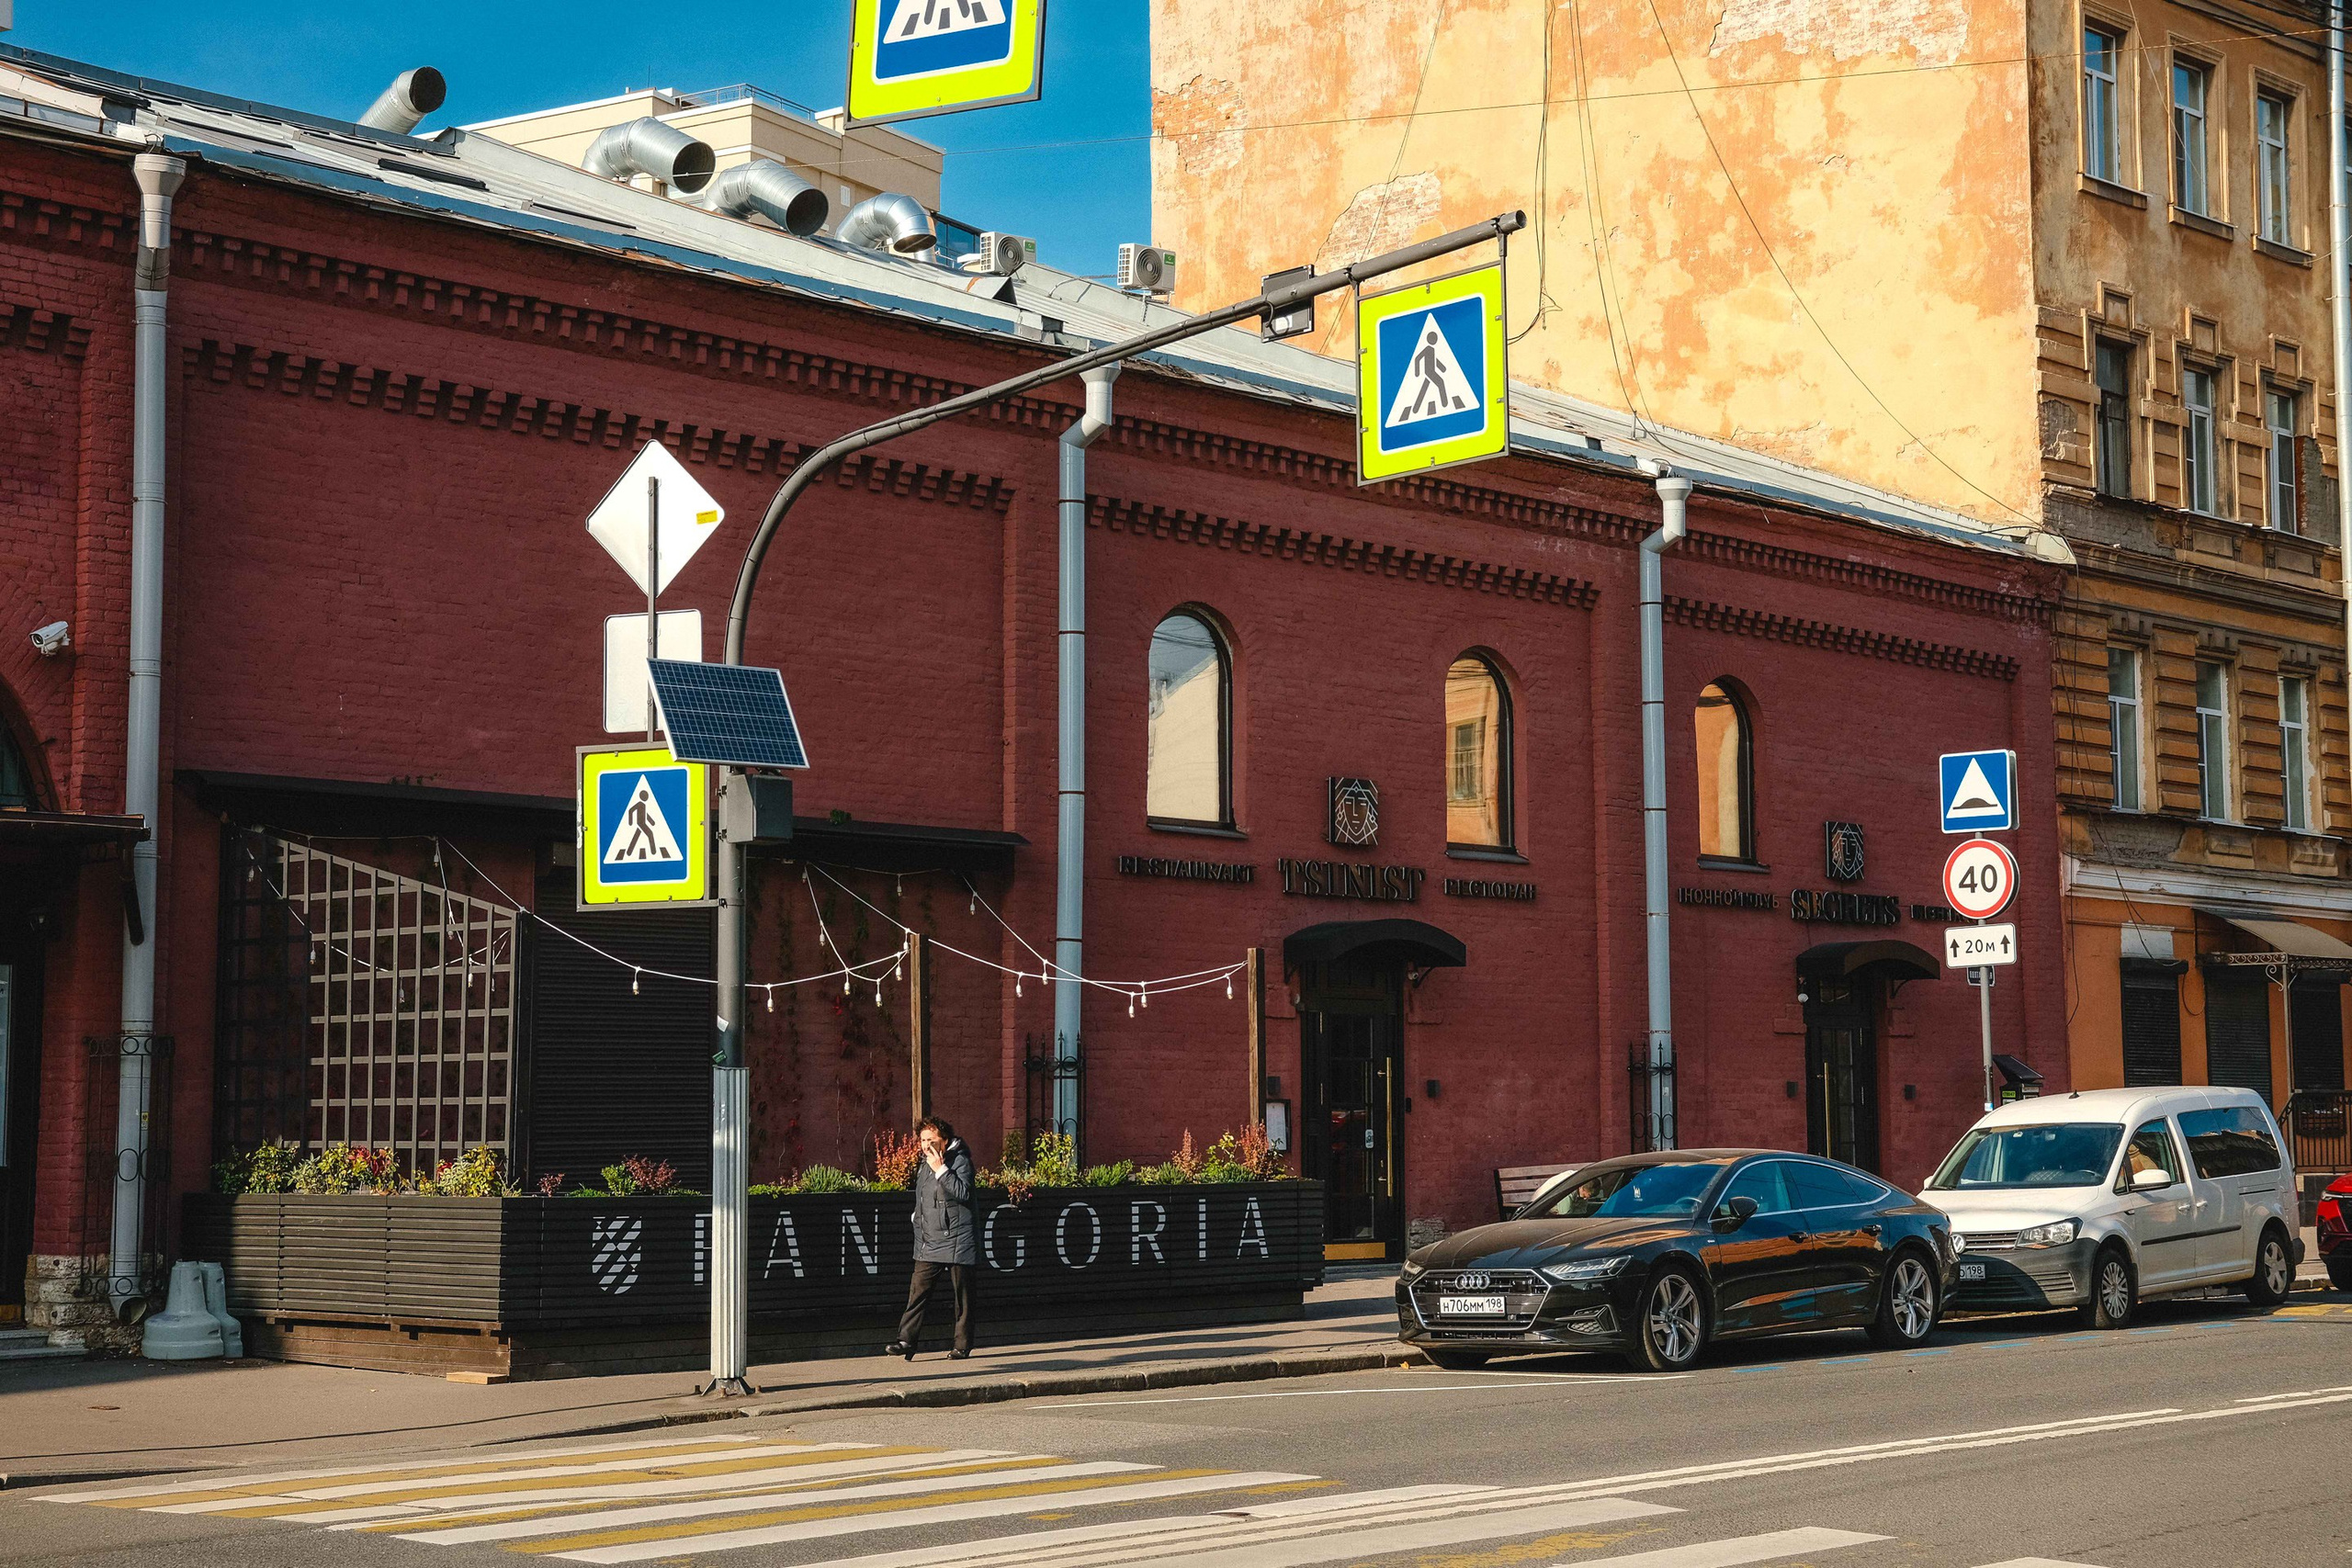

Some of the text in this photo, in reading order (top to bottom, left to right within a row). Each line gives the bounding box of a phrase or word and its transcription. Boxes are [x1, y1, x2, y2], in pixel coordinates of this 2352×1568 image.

[1277, 858, 1426, 902] TSINIST
[1959, 863, 1997, 894] 40
[694, 1197, 1271, 1286] FANGORIA
